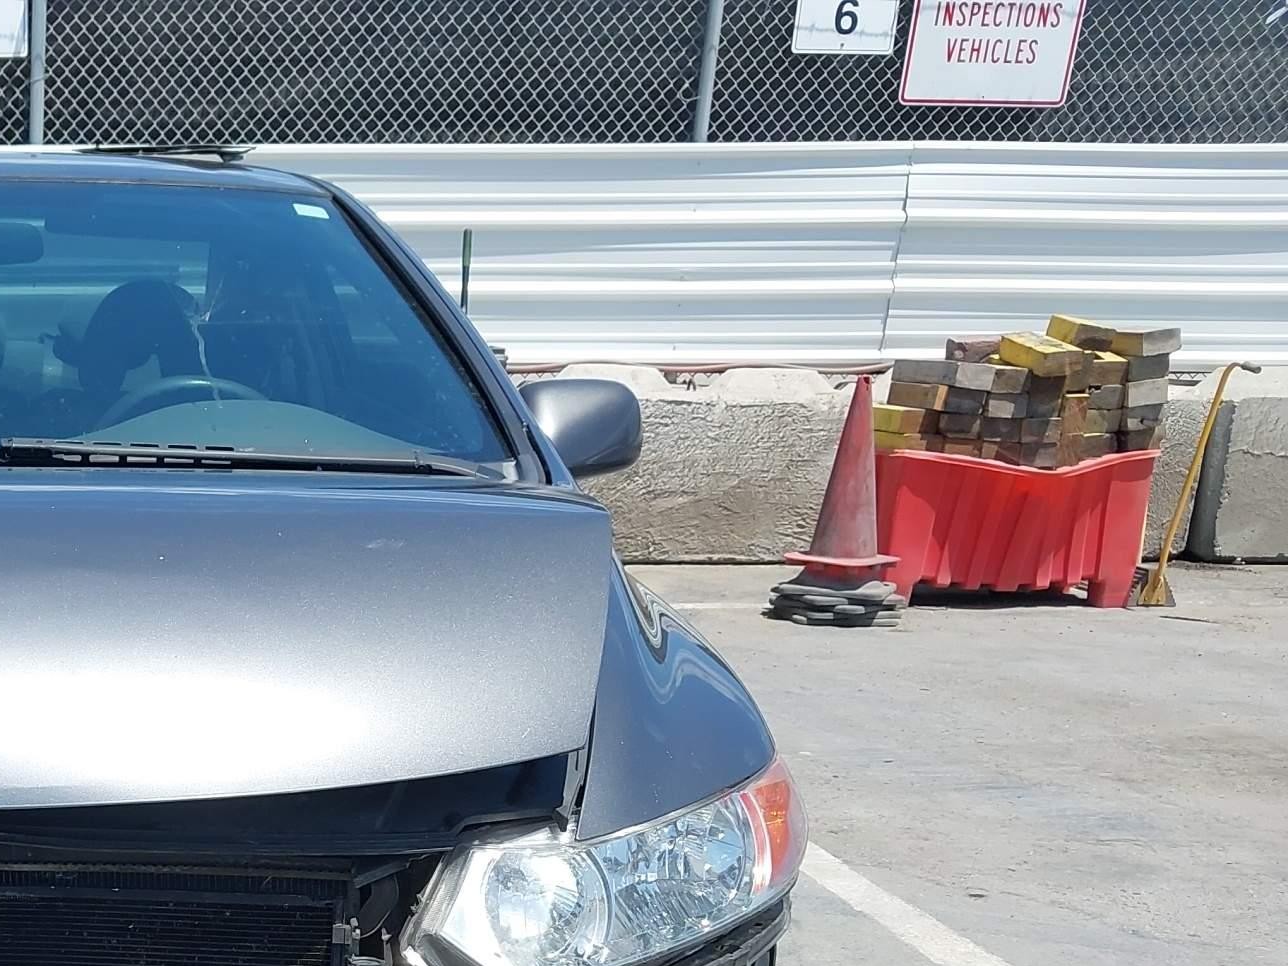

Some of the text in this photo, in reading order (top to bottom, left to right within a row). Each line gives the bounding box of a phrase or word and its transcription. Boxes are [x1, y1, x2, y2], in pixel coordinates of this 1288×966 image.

[834, 0, 859, 35] 6
[934, 1, 1063, 28] INSPECTIONS
[945, 38, 1039, 64] VEHICLES
